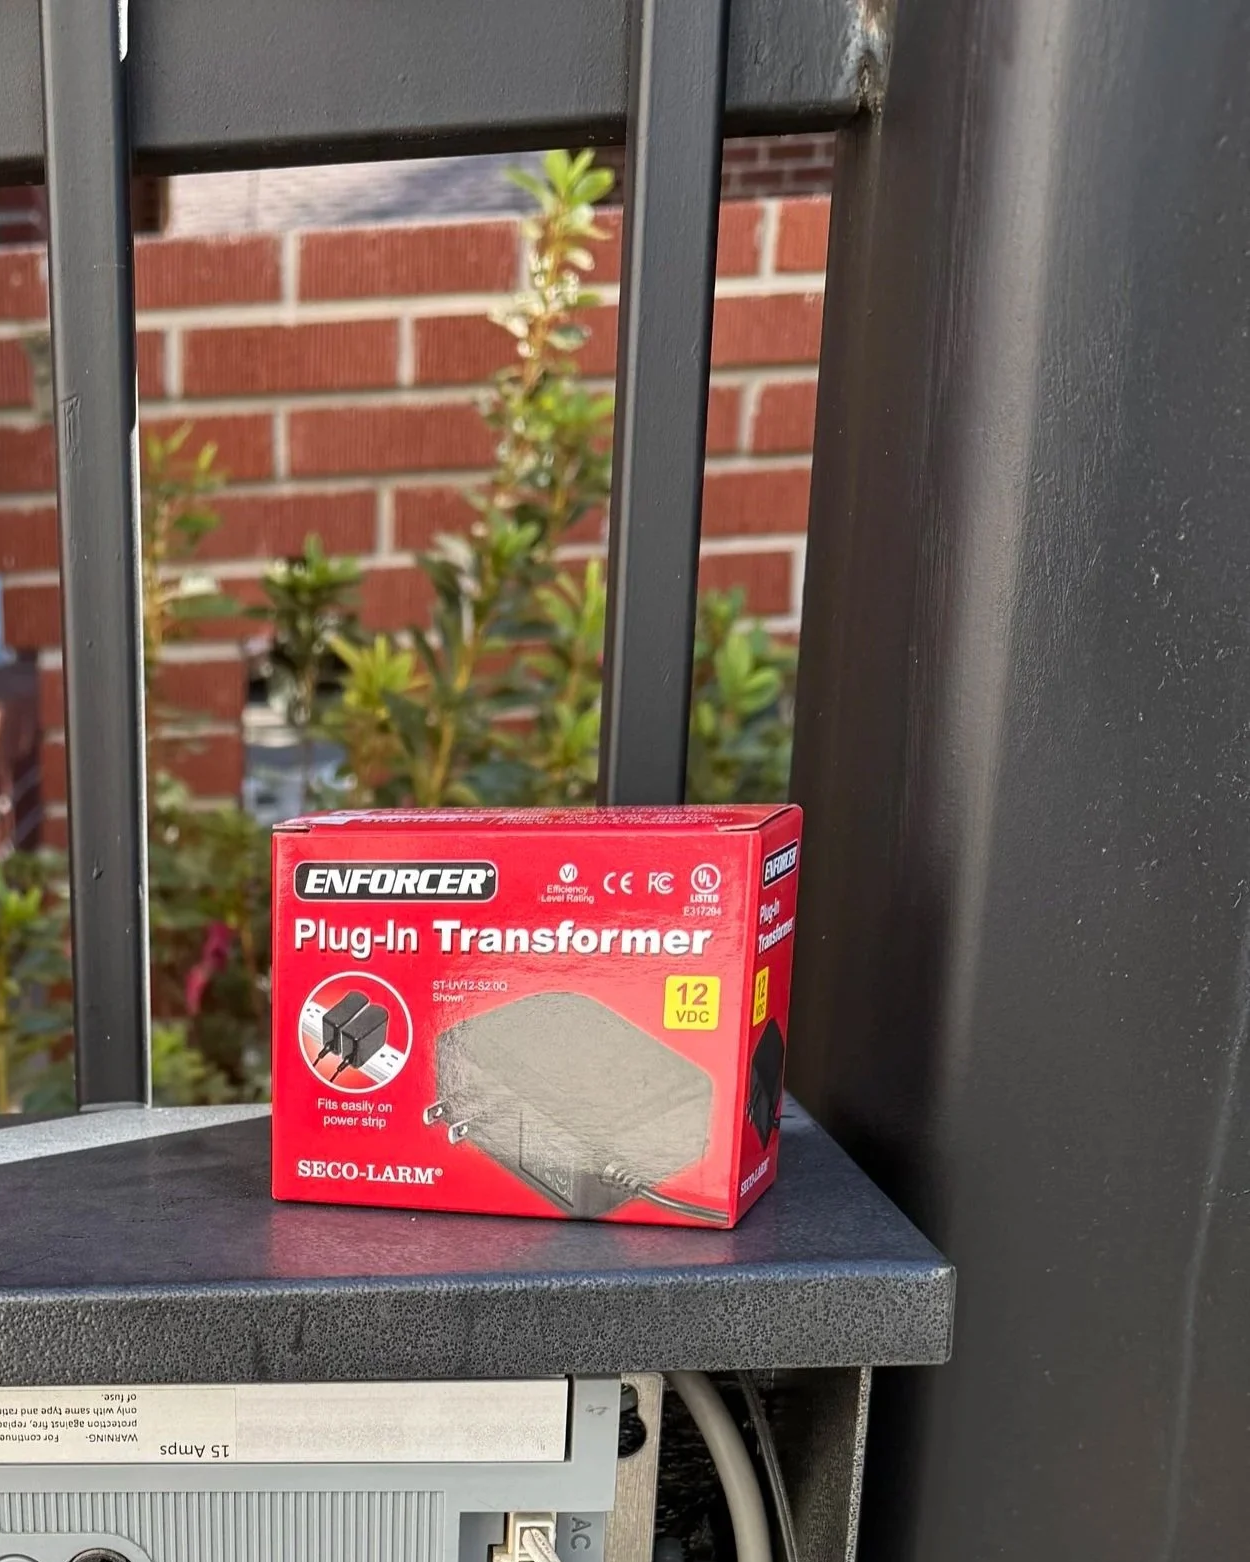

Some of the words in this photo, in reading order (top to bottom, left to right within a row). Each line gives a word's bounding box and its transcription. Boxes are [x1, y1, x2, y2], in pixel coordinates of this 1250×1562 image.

[562, 867, 575, 878] VI
[698, 867, 712, 888] UL
[603, 872, 633, 895] CE
[547, 885, 588, 895] Efficiency
[541, 894, 565, 904] Level
[566, 895, 594, 904] Rating
[690, 895, 719, 903] LISTED
[294, 918, 419, 959] Plug-In
[432, 920, 713, 958] Transformer
[433, 993, 464, 1003] Shown
[676, 983, 709, 1006] 12
[676, 1011, 710, 1023] VDC
[317, 1098, 338, 1110] Fits
[341, 1101, 375, 1114] easily
[379, 1103, 392, 1113] on
[324, 1115, 358, 1127] power
[362, 1116, 386, 1129] strip
[101, 1393, 124, 1402] fuse.
[127, 1393, 137, 1402] of
[21, 1407, 39, 1416] and
[41, 1406, 62, 1416] type
[65, 1407, 91, 1415] same
[93, 1406, 115, 1416] with
[117, 1406, 137, 1417] only
[29, 1419, 48, 1430] fire,
[50, 1419, 85, 1430] against
[88, 1419, 138, 1430] protection
[44, 1434, 59, 1443] For
[160, 1444, 205, 1458] Amps
[212, 1444, 230, 1458] 15
[570, 1517, 592, 1551] AC
